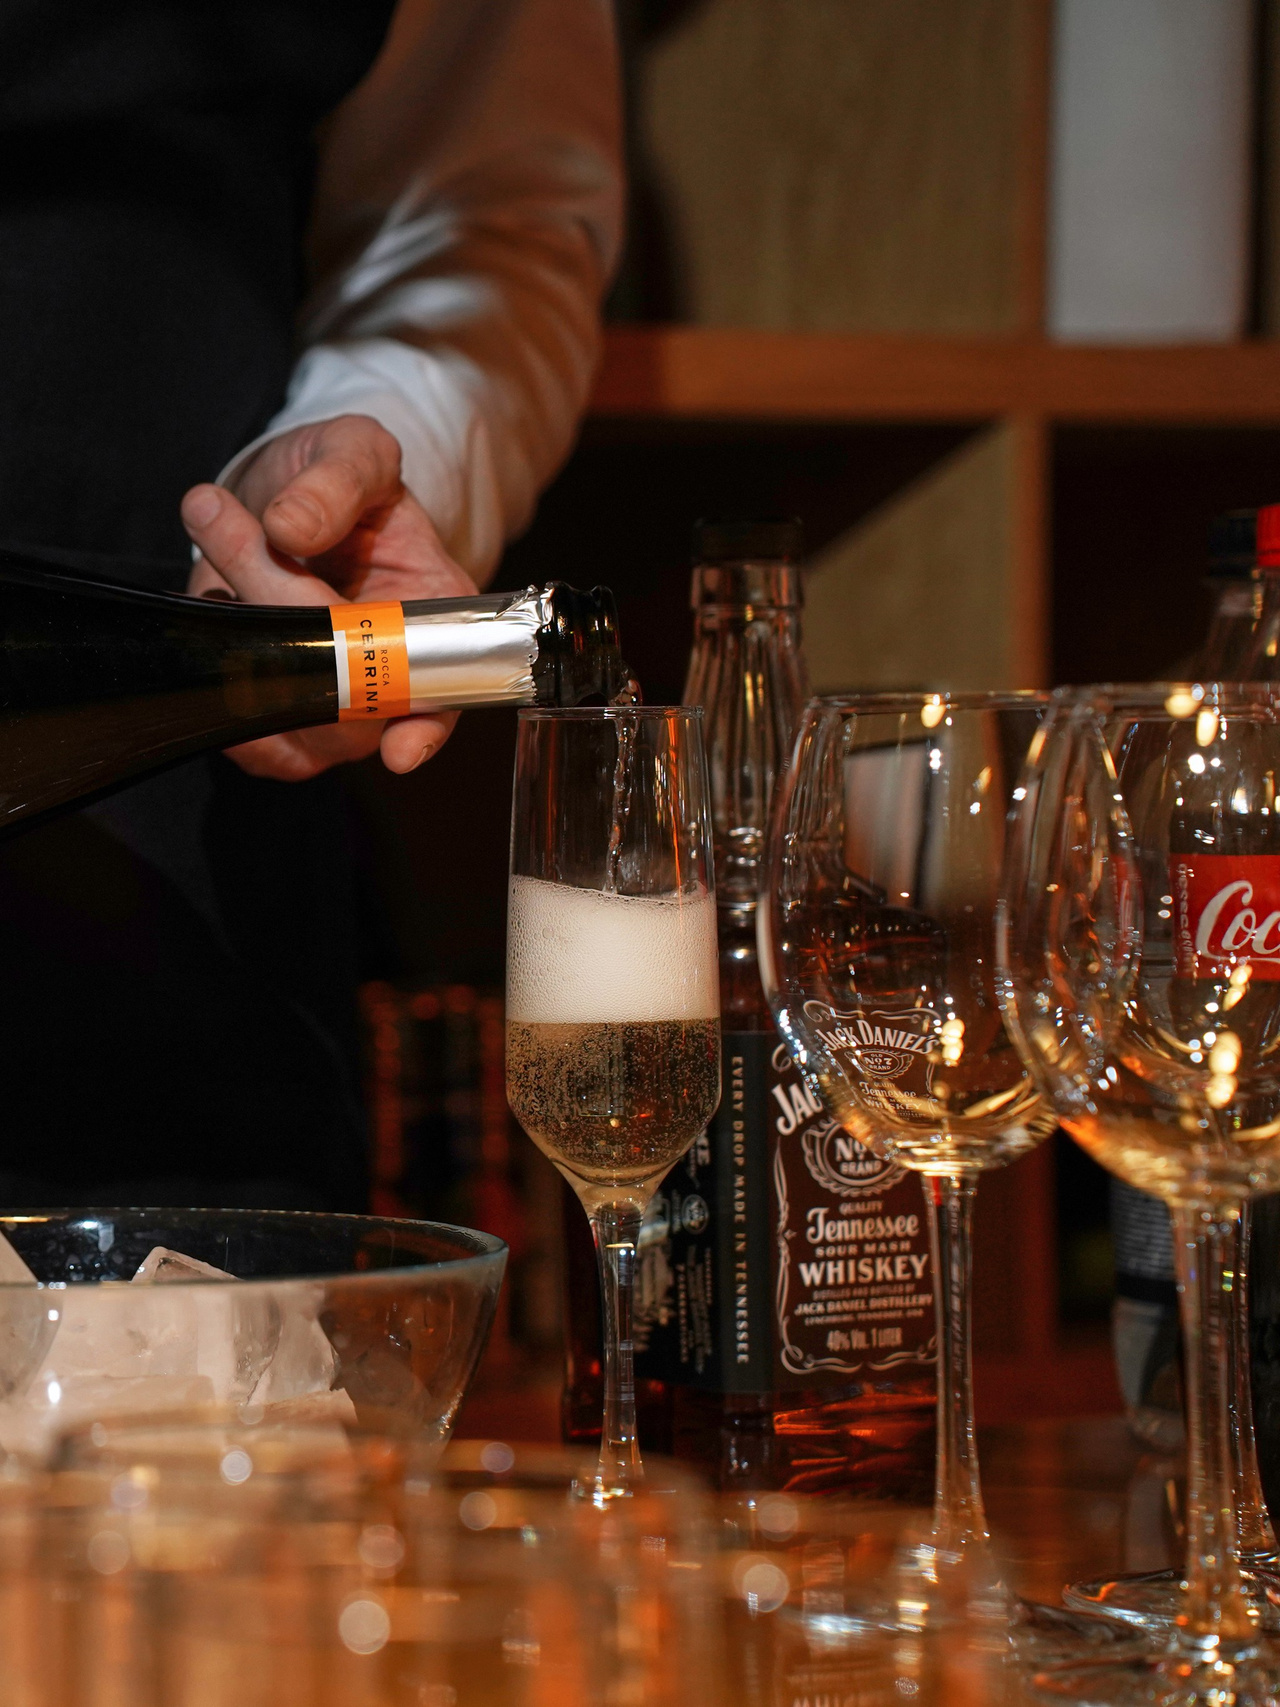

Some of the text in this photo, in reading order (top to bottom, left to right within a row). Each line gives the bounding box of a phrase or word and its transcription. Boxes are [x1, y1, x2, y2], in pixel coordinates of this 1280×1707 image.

[360, 619, 378, 713] CERRINA
[381, 649, 390, 686] ROCCA
[815, 1020, 940, 1054] JACK DANIEL'S
[859, 1082, 916, 1098] Tennessee
[863, 1098, 922, 1110] WHISKEY
[771, 1082, 824, 1136] JAC
[839, 1160, 882, 1176] BRAND
[732, 1056, 749, 1364] EVERY DROP MADE IN TENNESSEE
[839, 1200, 883, 1215] QUALITY
[806, 1206, 919, 1244] Tennessee
[815, 1240, 911, 1258] SOUR MASH
[798, 1254, 928, 1287] WHISKEY
[794, 1293, 933, 1316] JACK DANIEL DISTILLERY
